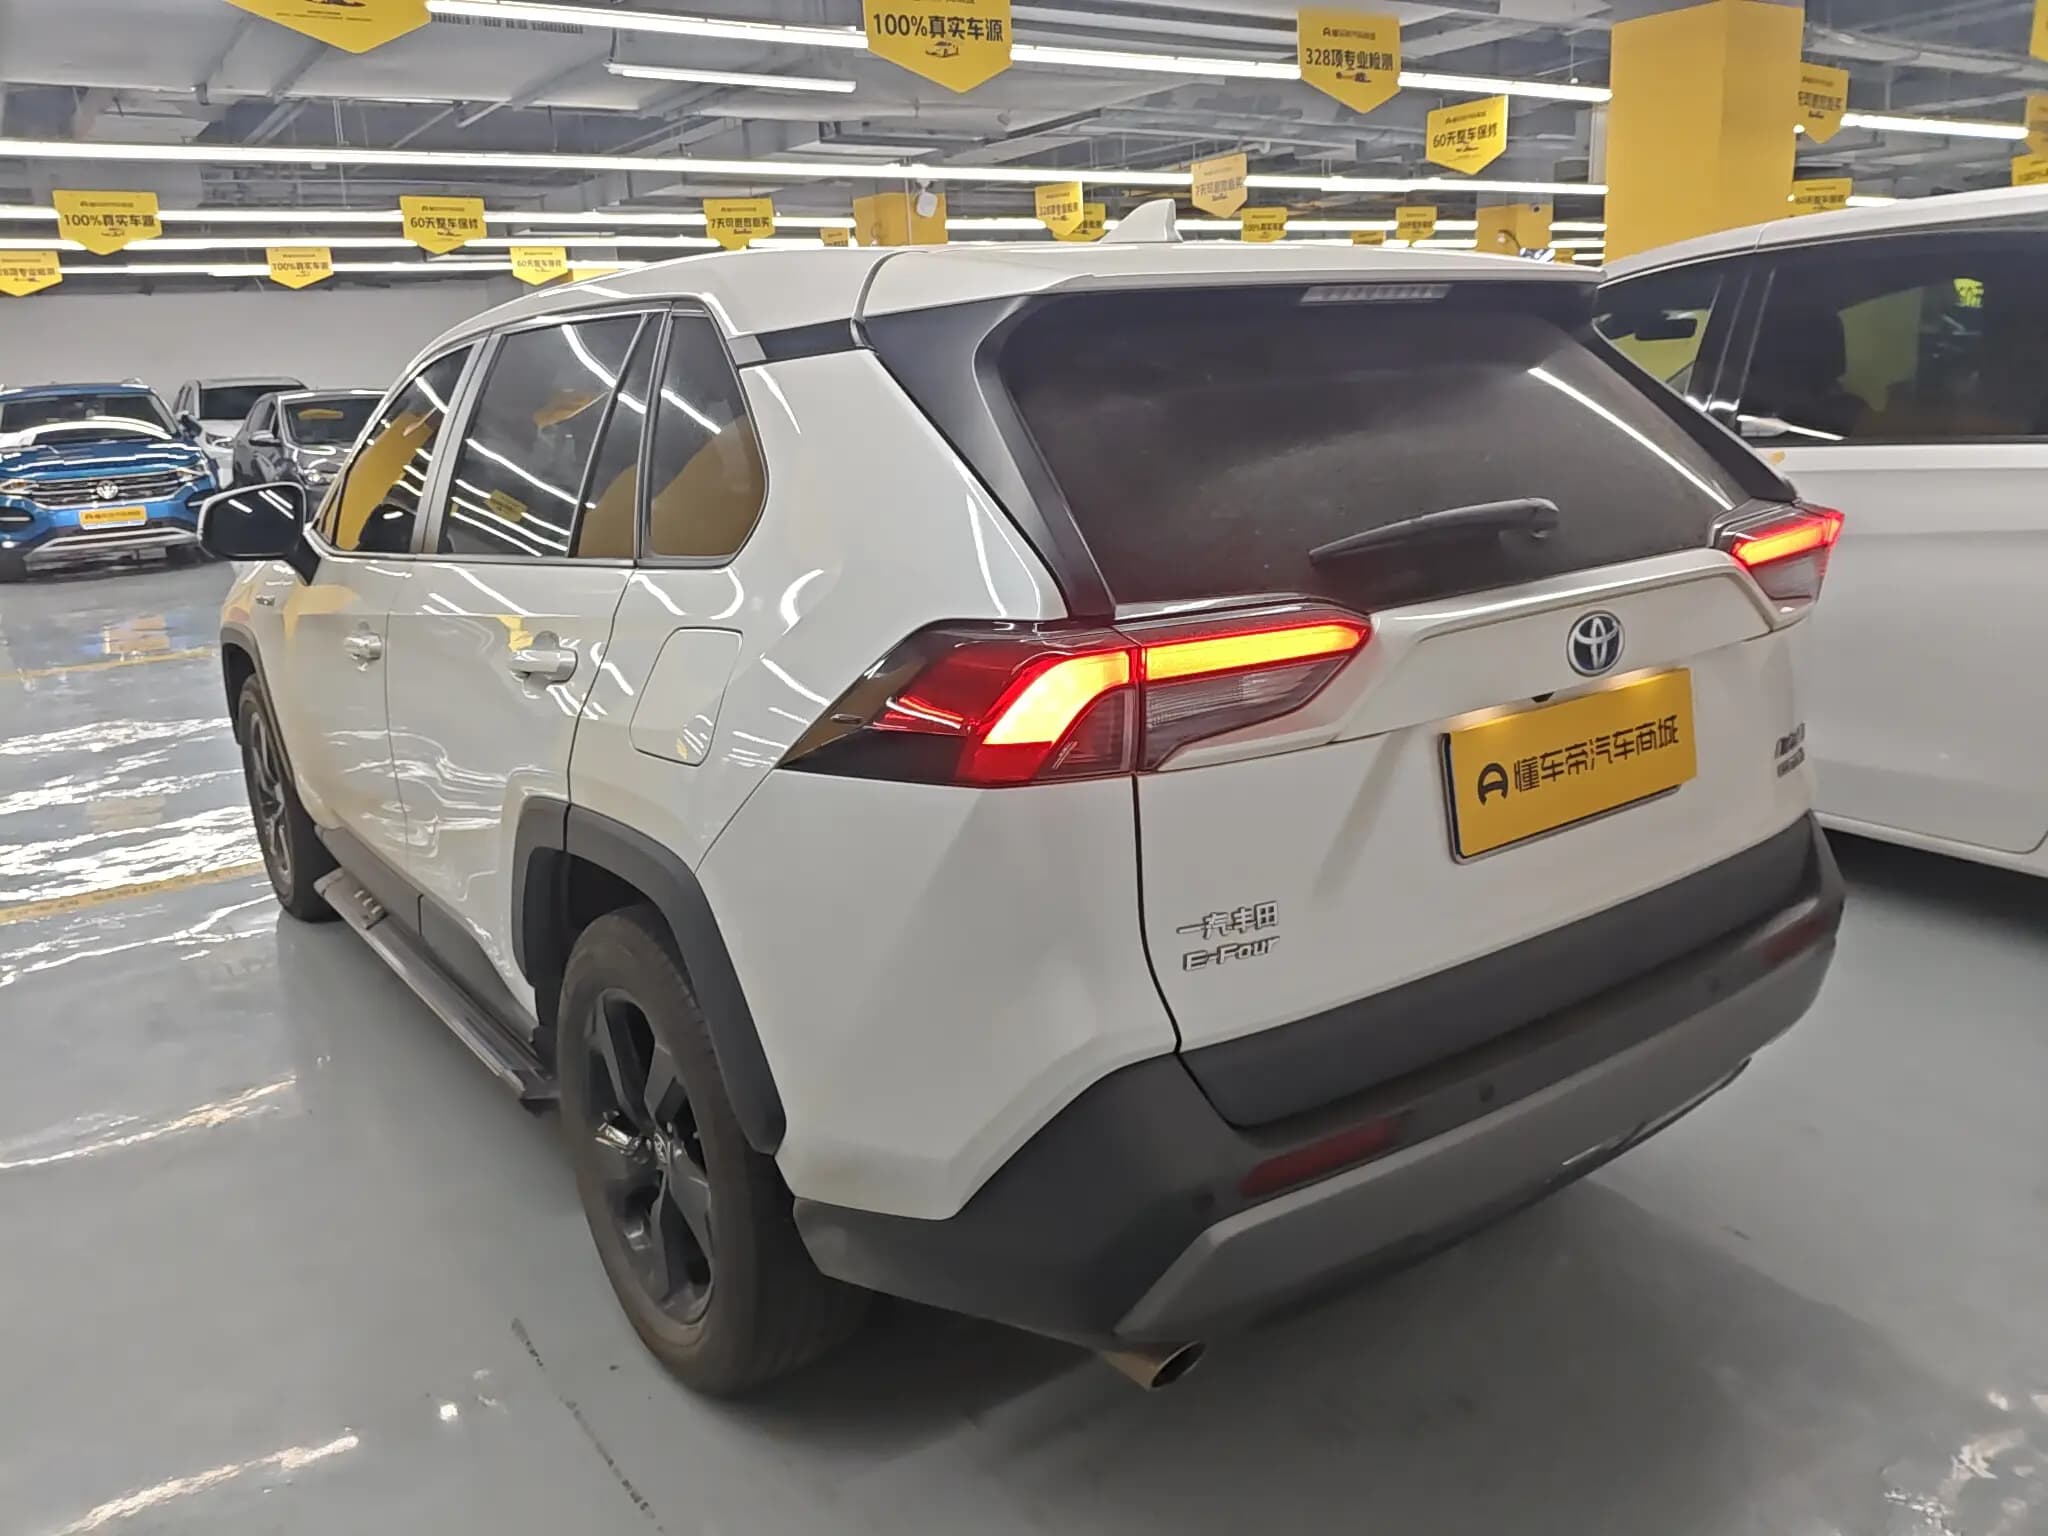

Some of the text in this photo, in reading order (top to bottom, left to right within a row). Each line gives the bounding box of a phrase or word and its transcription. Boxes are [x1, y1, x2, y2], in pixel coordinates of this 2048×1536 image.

[873, 13, 1003, 42] 100%真实车源
[1306, 47, 1393, 71] 328项专业检测
[1433, 122, 1497, 148] 60天整车保修
[64, 214, 156, 227] 100%真实车源
[410, 217, 478, 229] 60天整车保修
[1513, 714, 1679, 793] 懂车帝汽车商城
[1176, 900, 1279, 940] 一汽丰田
[1183, 935, 1280, 971] E-Four
